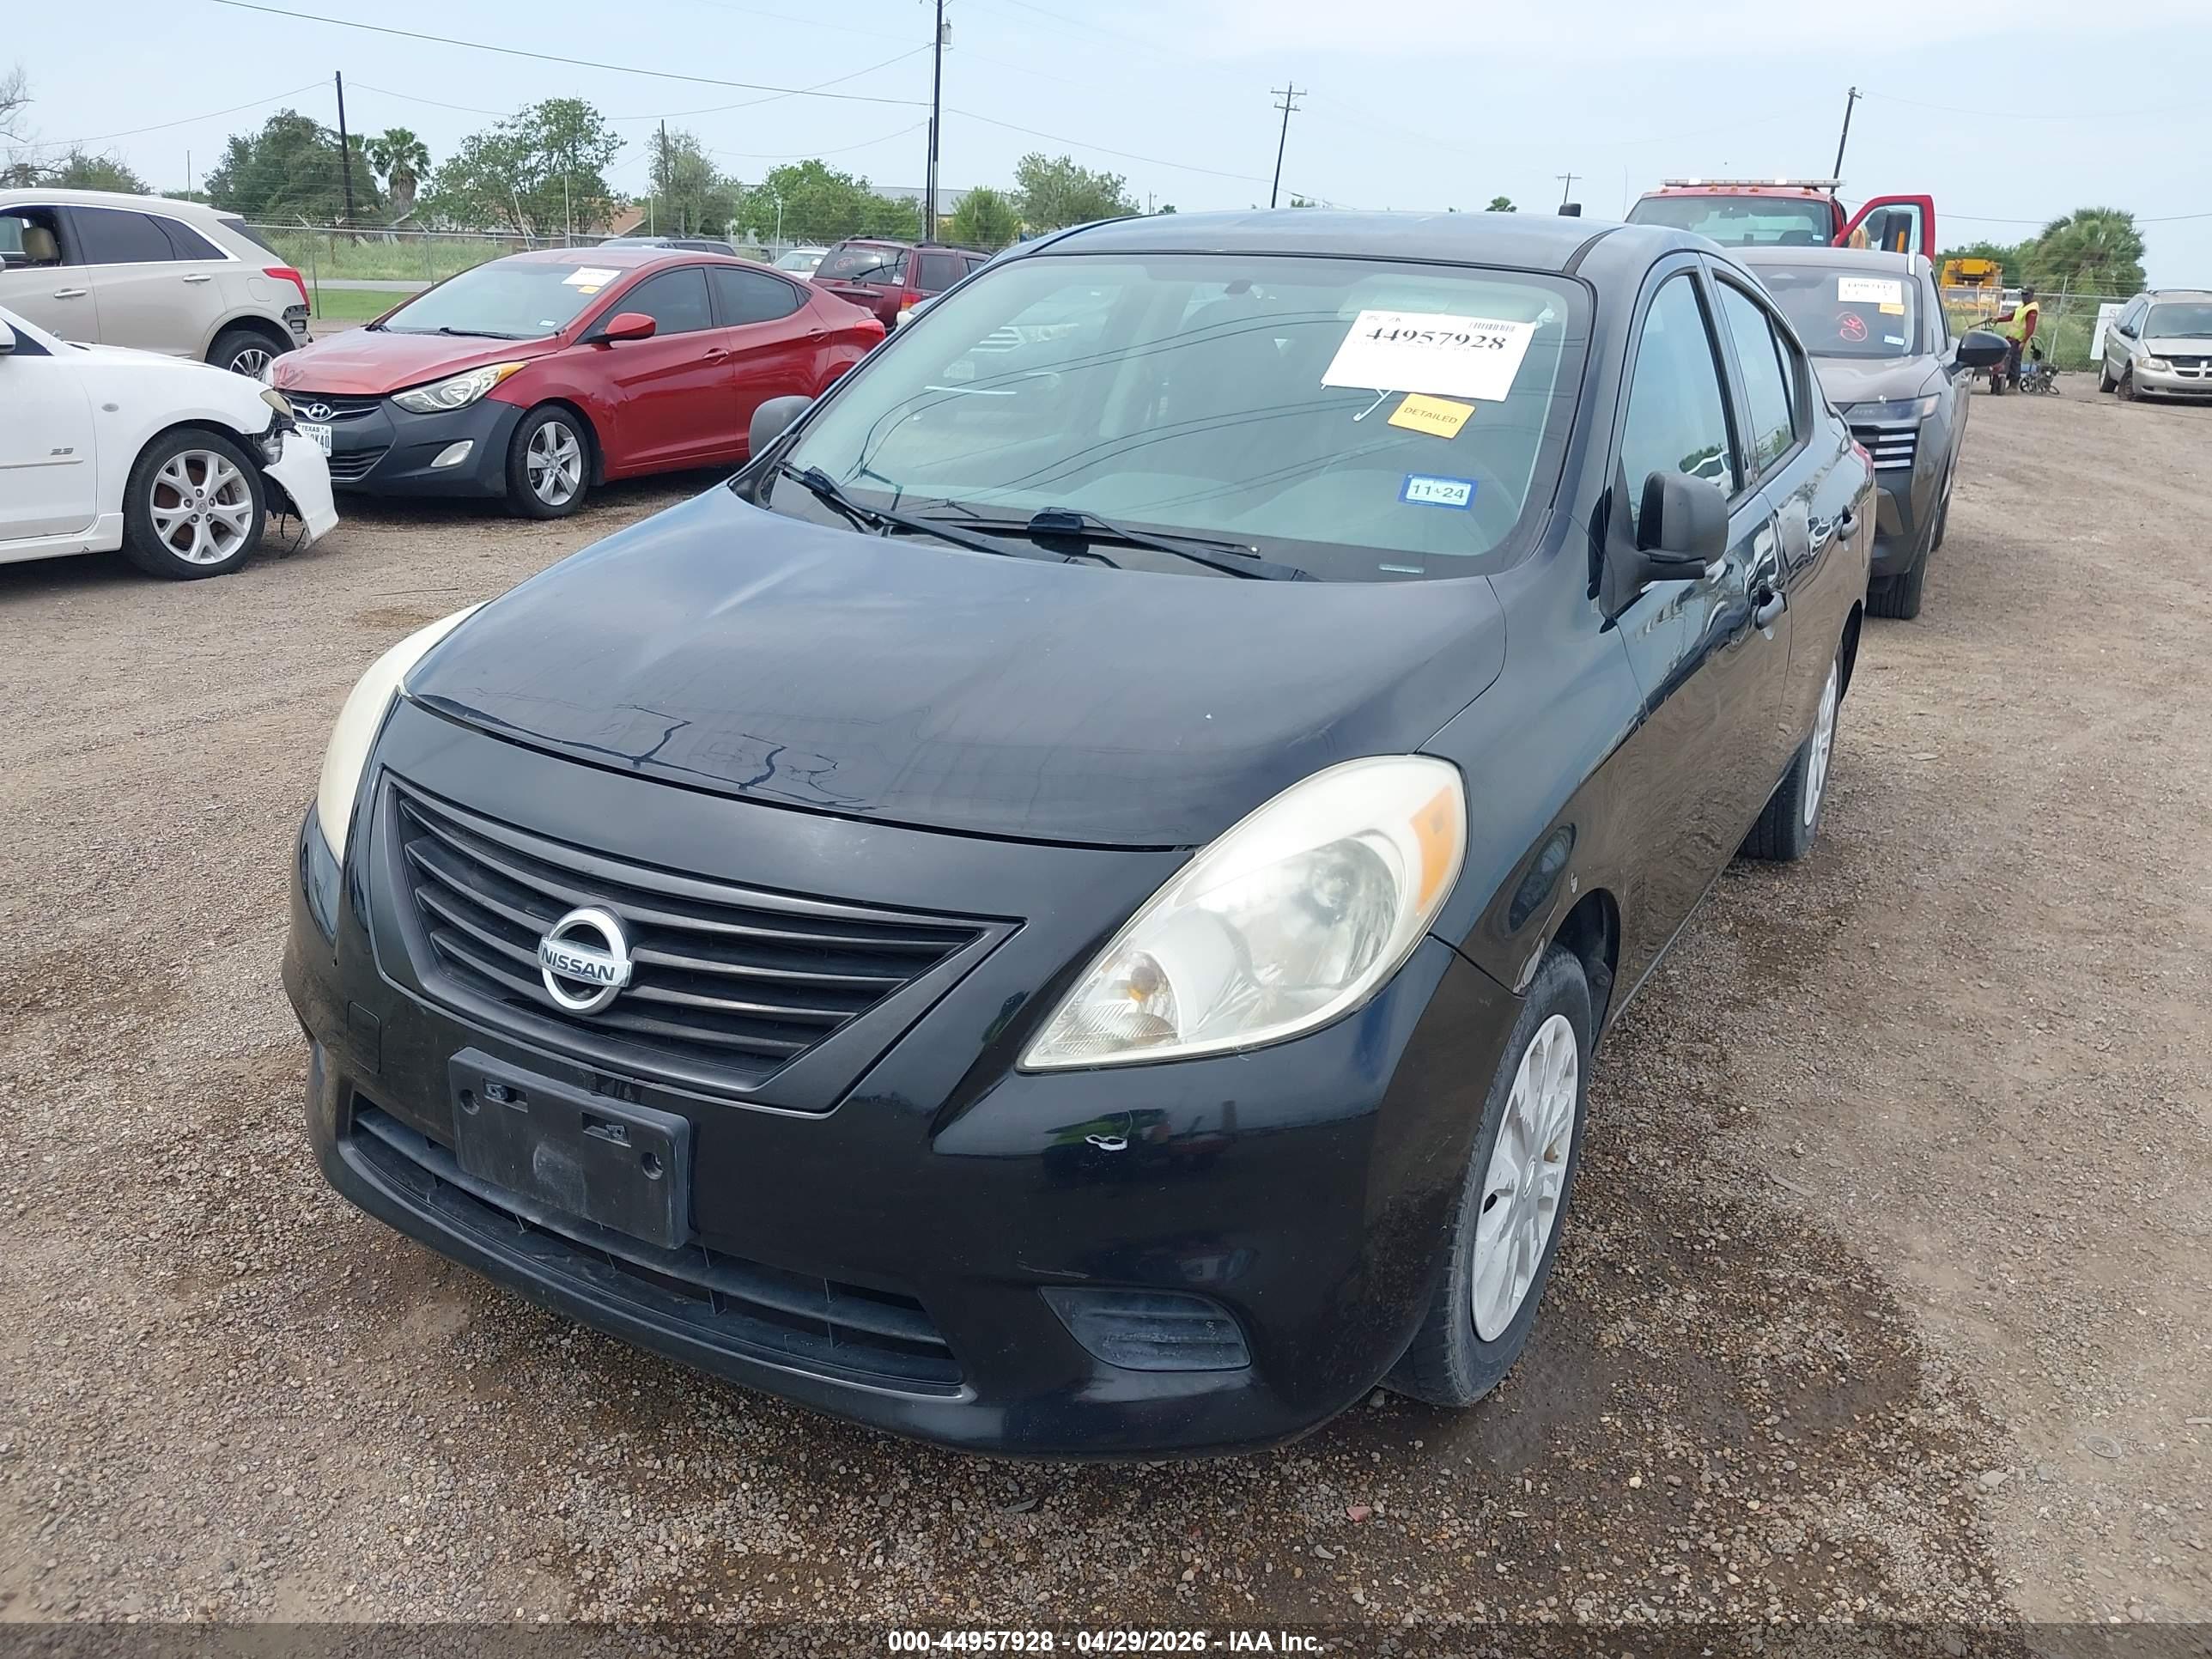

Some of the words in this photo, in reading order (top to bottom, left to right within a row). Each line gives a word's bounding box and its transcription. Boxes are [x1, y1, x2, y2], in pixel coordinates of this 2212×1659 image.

[1365, 327, 1506, 350] 44957928
[1403, 406, 1458, 425] DETAILED
[541, 947, 616, 981] NISSAN
